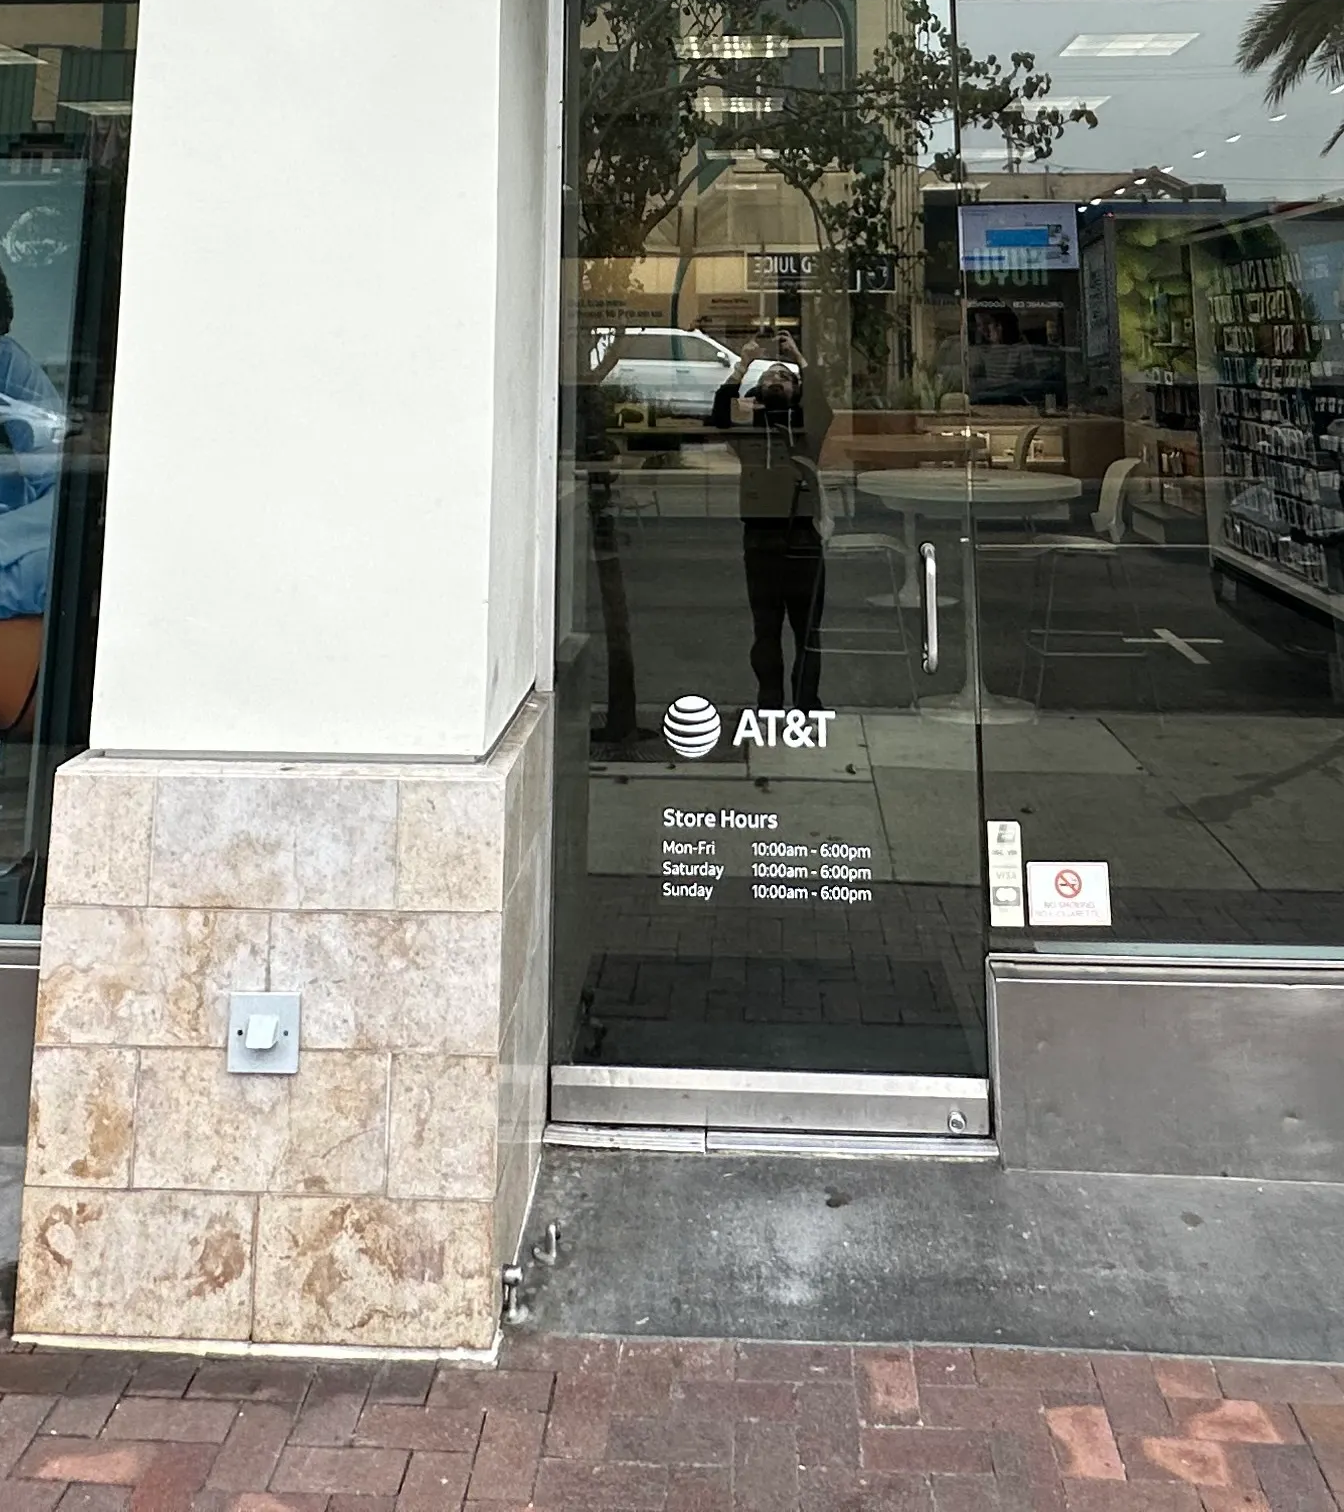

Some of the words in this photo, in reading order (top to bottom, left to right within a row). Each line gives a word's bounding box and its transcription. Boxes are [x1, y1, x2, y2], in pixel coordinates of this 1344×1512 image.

[733, 709, 836, 748] AT&T
[663, 808, 716, 828] Store
[721, 810, 778, 829] Hours
[662, 840, 716, 855] Mon-Fri
[751, 842, 808, 857] 10:00am
[820, 843, 871, 861] 6:00pm
[662, 861, 724, 880] Saturday
[752, 863, 808, 878] 10:00am
[820, 865, 872, 882] 6:00pm
[662, 882, 713, 900] Sunday
[752, 884, 808, 900] 10:00am
[820, 886, 872, 904] 6:00pm
